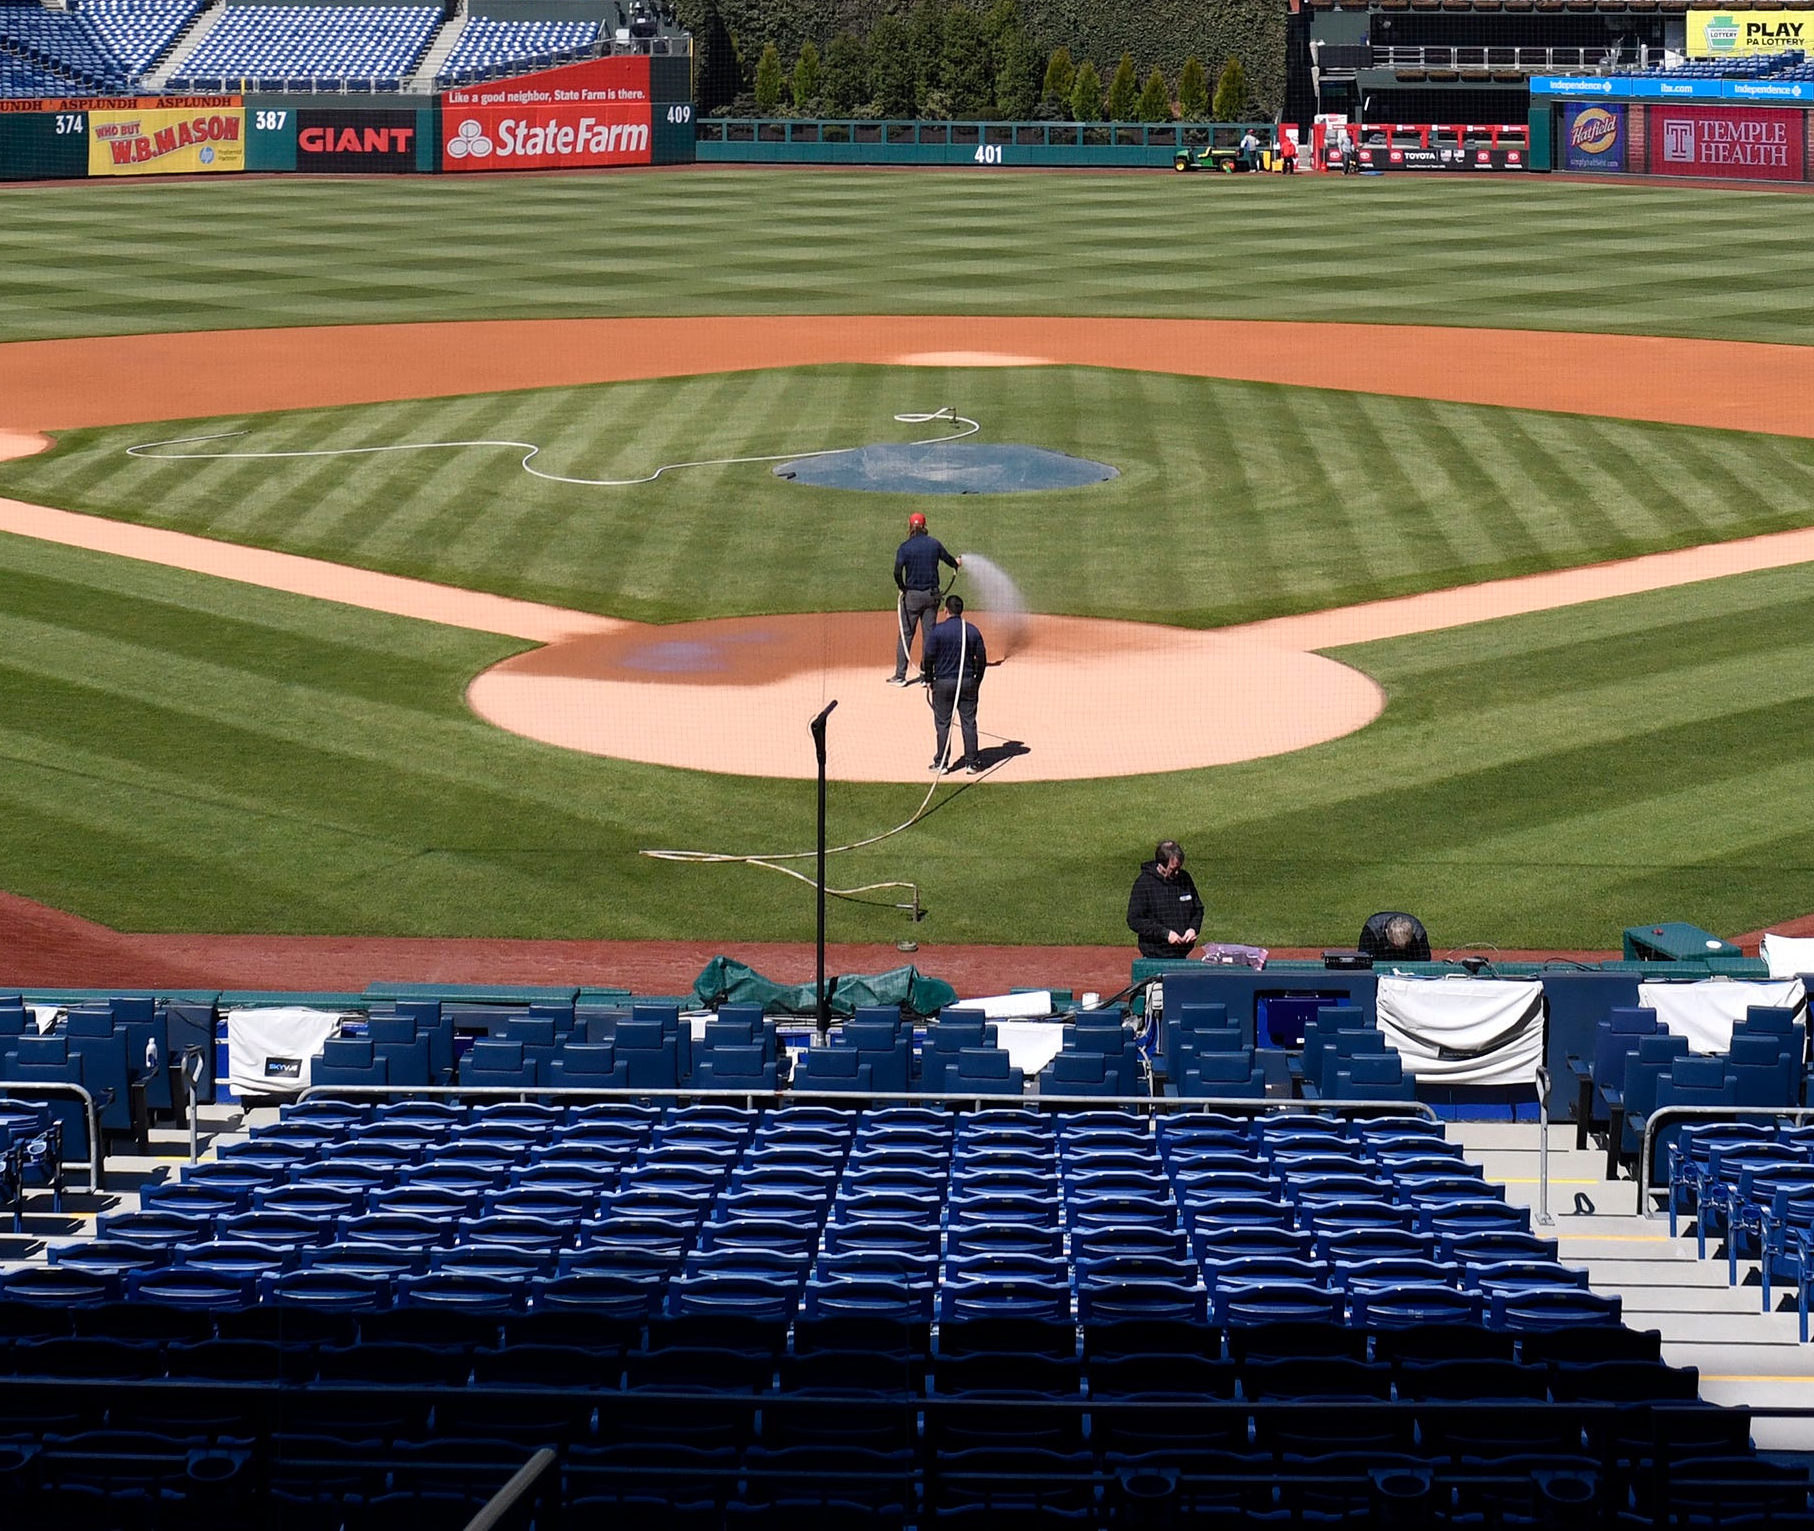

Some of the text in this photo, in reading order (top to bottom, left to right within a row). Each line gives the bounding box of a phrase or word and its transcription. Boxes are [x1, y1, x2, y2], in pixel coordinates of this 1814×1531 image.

[1746, 22, 1805, 36] PLAY
[1761, 38, 1805, 46] LOTTERY
[59, 97, 231, 110] ASPLUNDH ASPLUNDH
[449, 91, 466, 103] Like
[480, 90, 504, 104] good
[507, 89, 552, 103] neighbor,
[555, 89, 579, 100] State
[582, 89, 606, 100] Farm
[607, 89, 615, 100] is
[617, 88, 645, 99] there.
[55, 114, 83, 134] 374
[256, 111, 286, 129] 387
[666, 105, 691, 124] 409
[95, 123, 140, 138] WHO BUT
[298, 127, 414, 153] GIANT
[1571, 116, 1616, 146] Hatfield
[1698, 120, 1787, 142] TEMPLE
[974, 144, 1003, 163] 401
[1699, 143, 1788, 166] HEALTH
